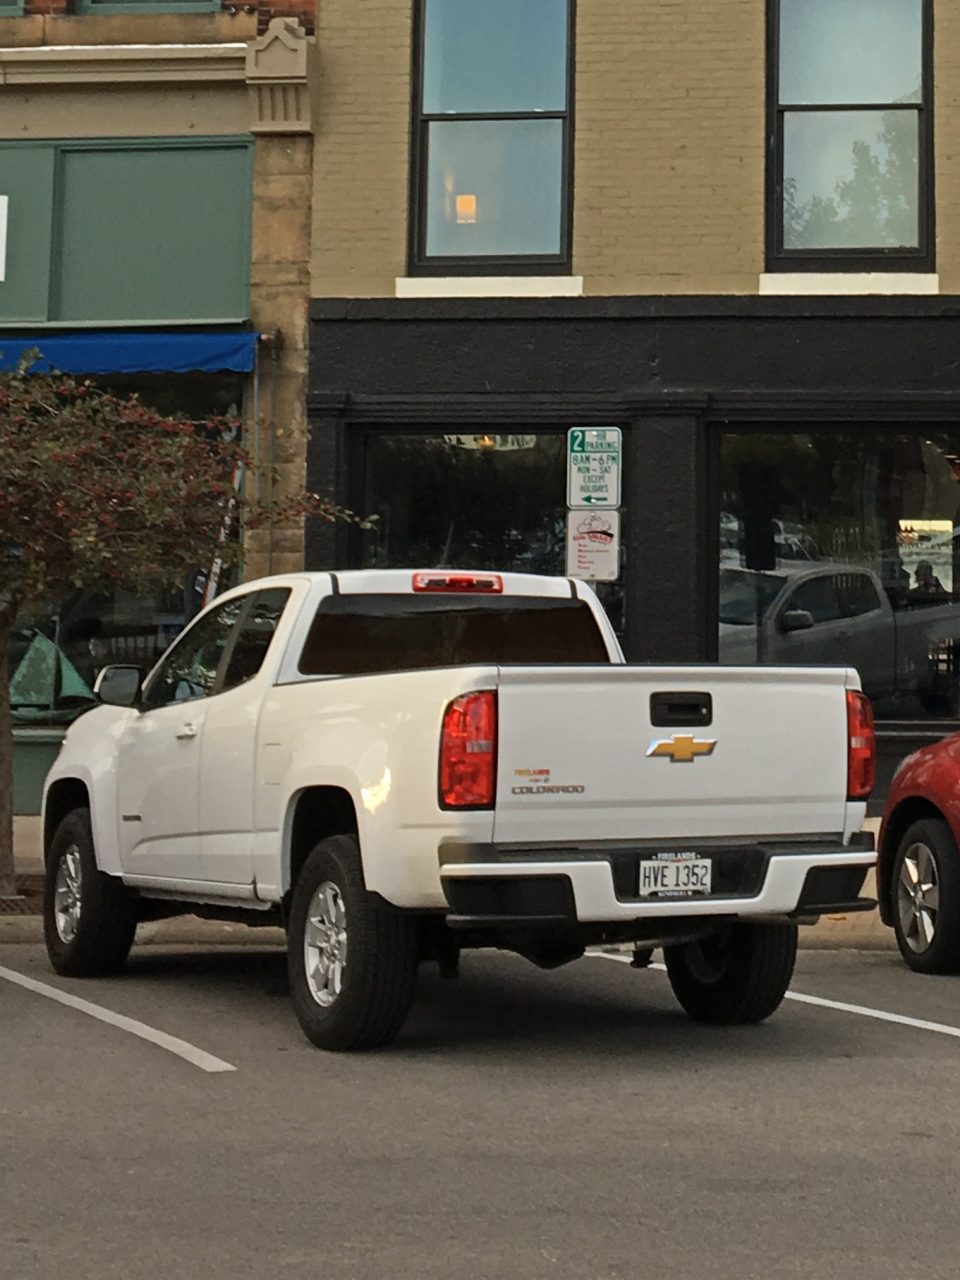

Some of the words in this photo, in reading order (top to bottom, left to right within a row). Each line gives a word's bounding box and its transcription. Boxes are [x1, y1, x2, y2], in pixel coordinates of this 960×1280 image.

[573, 431, 583, 451] 2
[586, 441, 618, 450] PARKING
[511, 785, 585, 795] COLORADO
[643, 866, 669, 888] HVE
[674, 864, 708, 887] 1352
